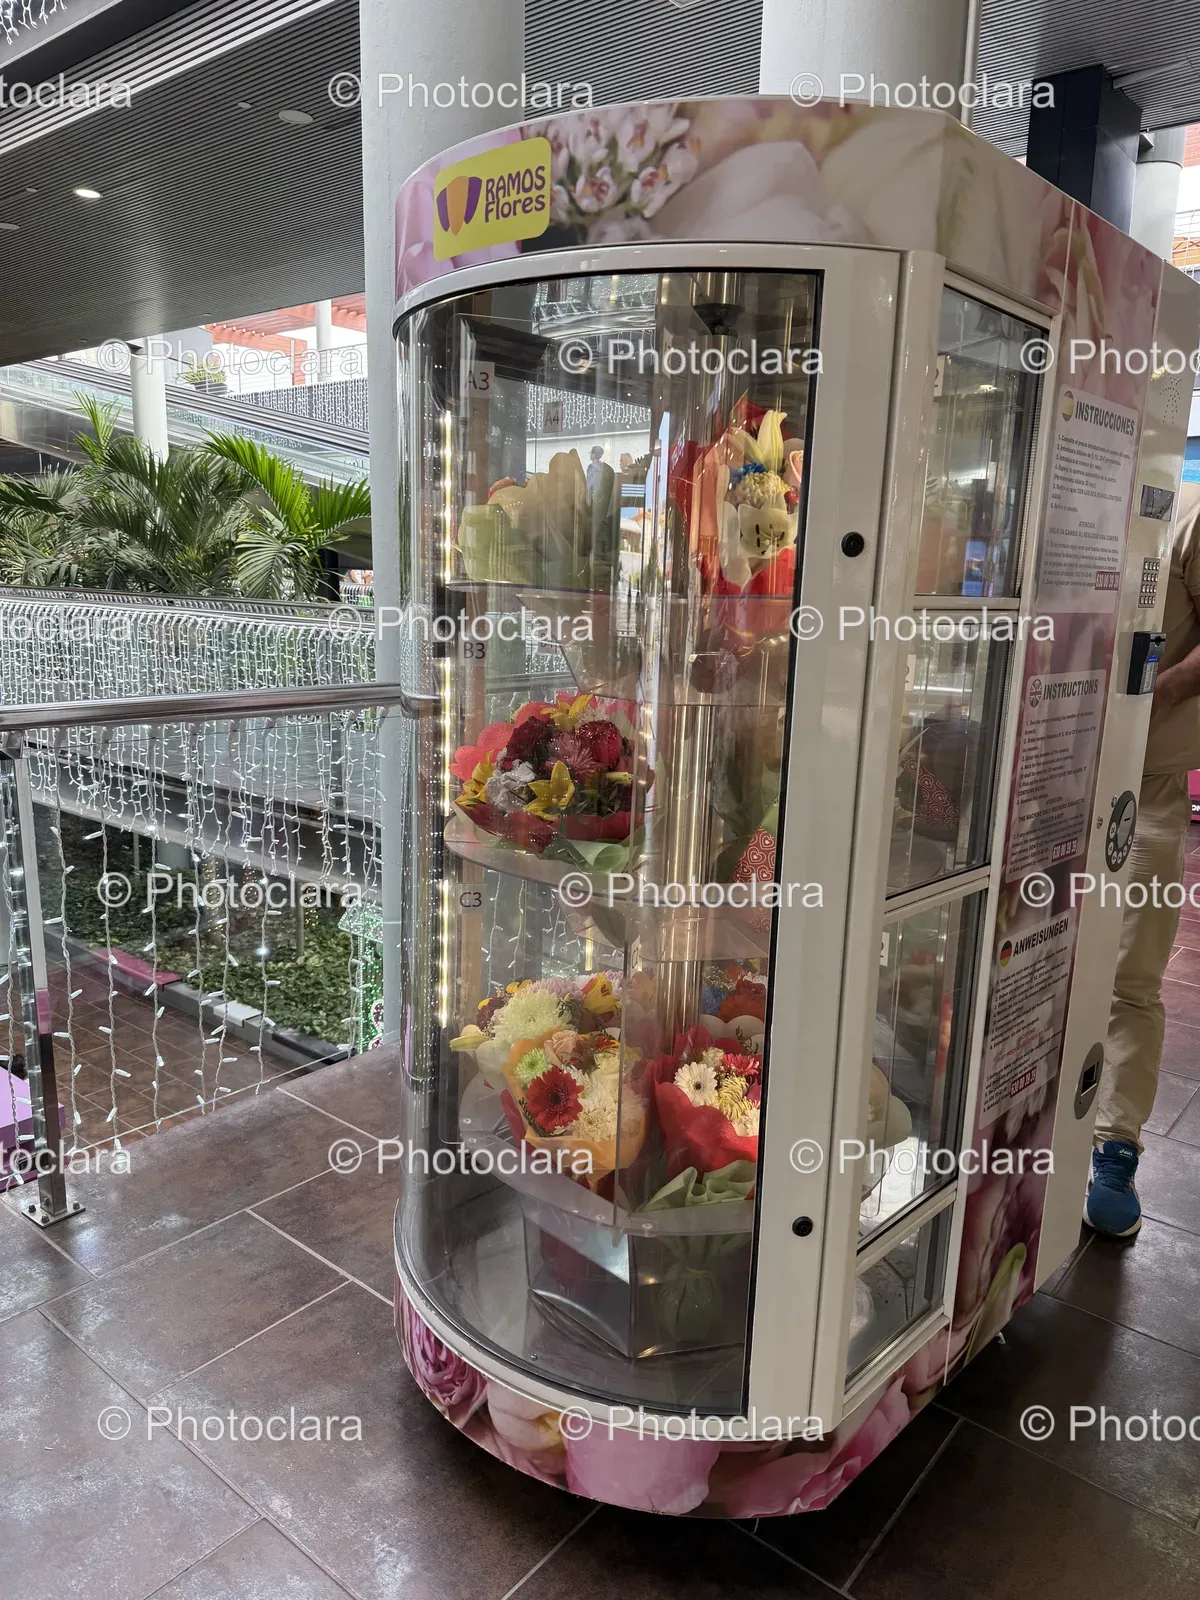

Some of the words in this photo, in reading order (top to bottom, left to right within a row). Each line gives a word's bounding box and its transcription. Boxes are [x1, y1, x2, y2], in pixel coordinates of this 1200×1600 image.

[485, 165, 546, 203] RAMOS
[484, 193, 546, 223] Flores
[466, 371, 490, 391] A3
[544, 415, 560, 427] A4
[1075, 400, 1135, 437] INSTRUCCIONES
[463, 642, 486, 660] B3
[1043, 678, 1099, 701] INSTRUCTIONS
[459, 892, 482, 908] C3
[1013, 917, 1069, 957] ANWEISUNGEN
